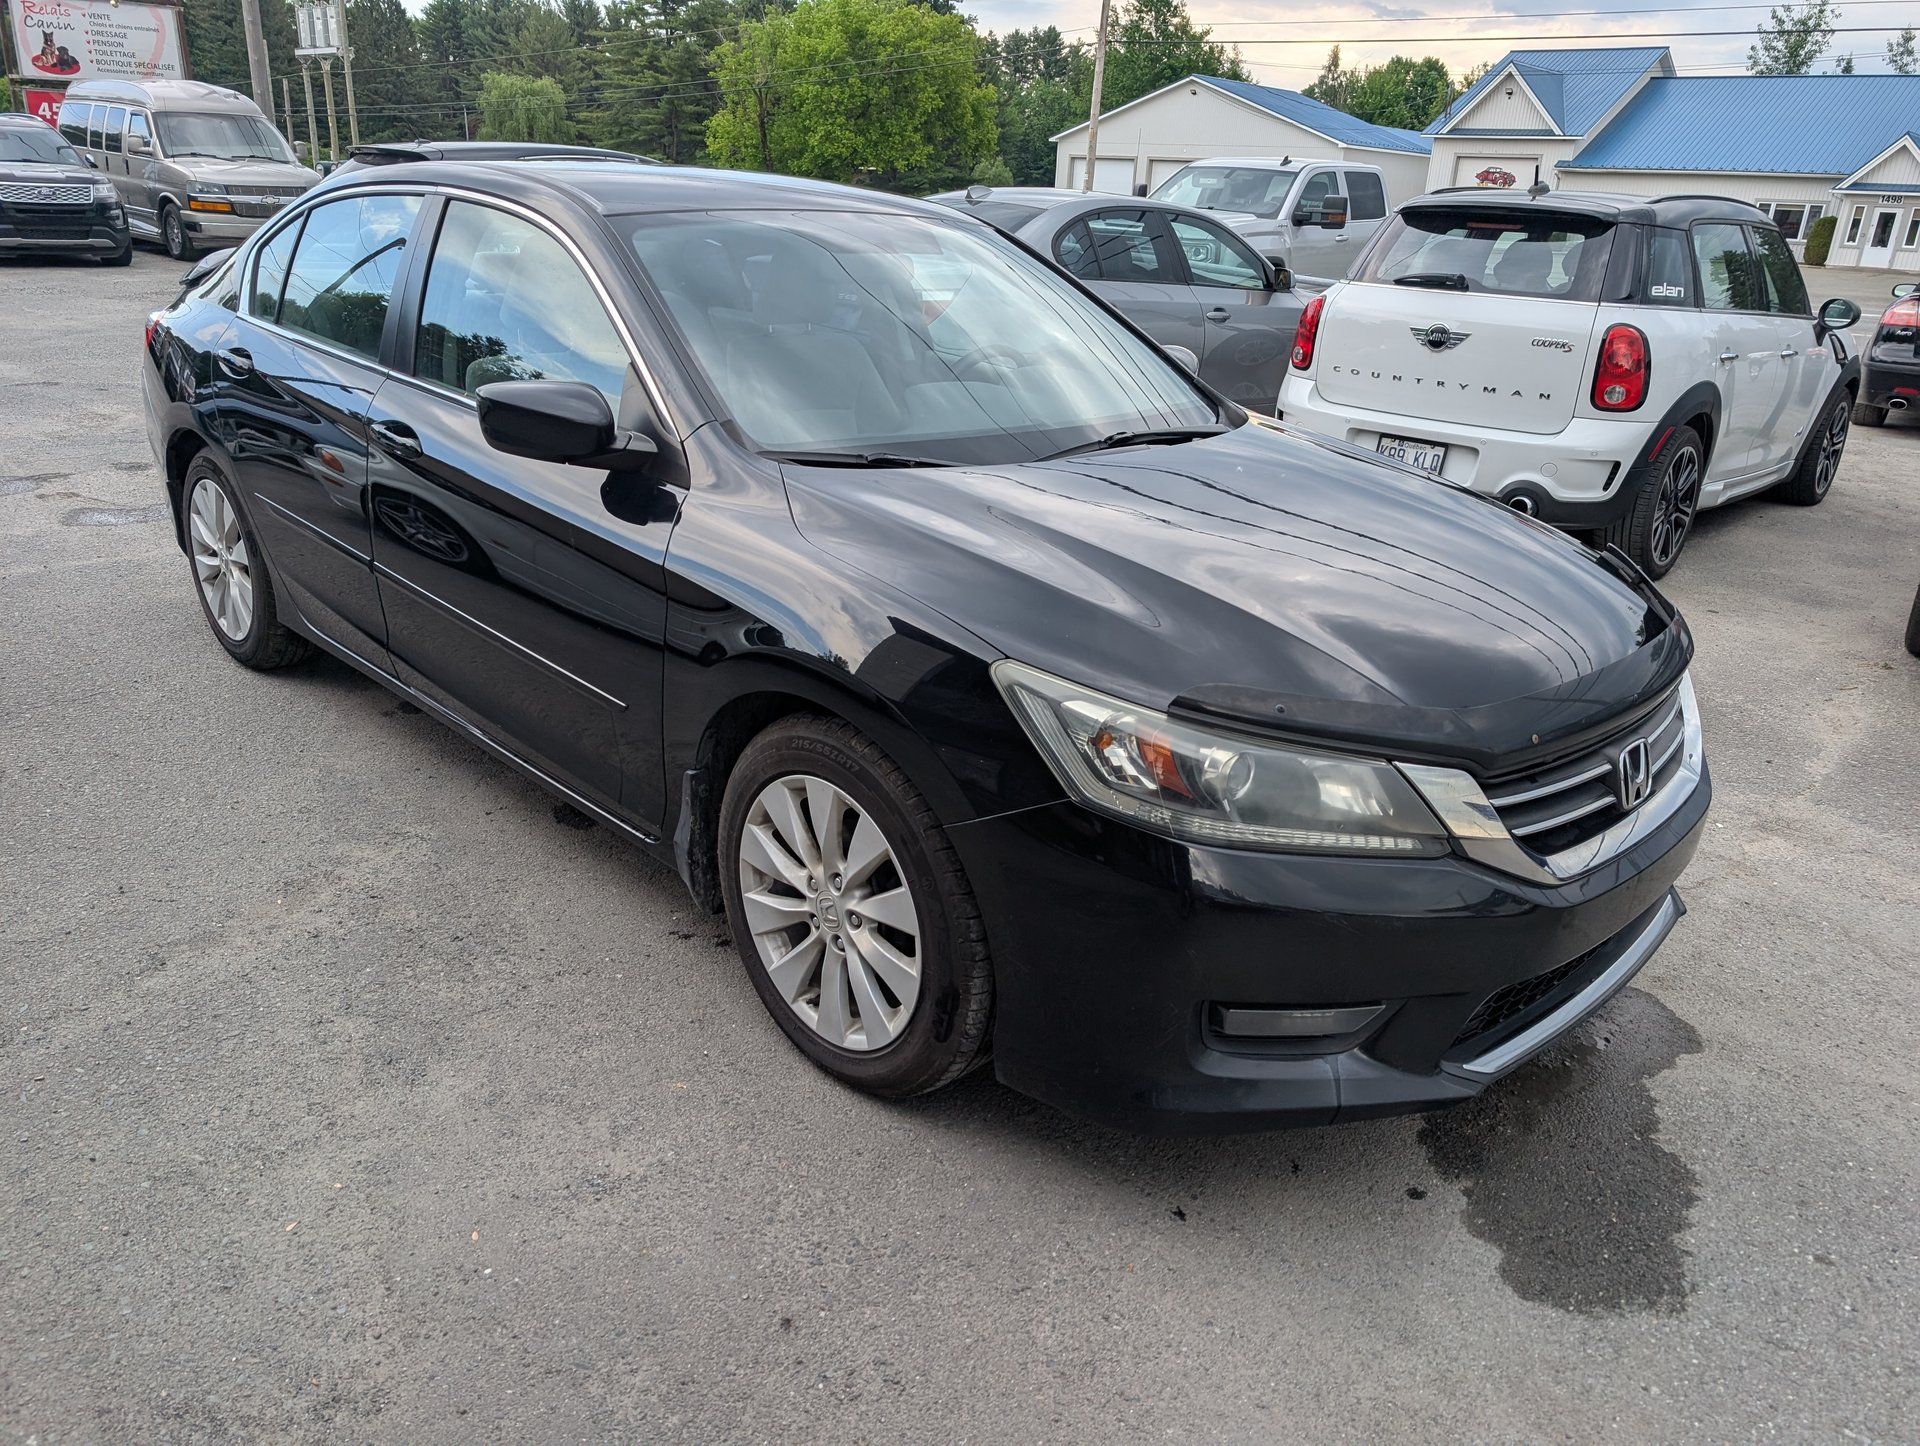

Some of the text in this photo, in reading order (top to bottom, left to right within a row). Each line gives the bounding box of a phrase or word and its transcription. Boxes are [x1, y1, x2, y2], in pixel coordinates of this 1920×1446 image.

[20, 1, 71, 17] Relais
[87, 13, 112, 21] VENTE
[24, 15, 75, 30] Canin
[91, 29, 128, 39] DRESSAGE
[92, 39, 124, 48] PENSION
[94, 49, 136, 58] TOILETTAGE
[95, 59, 132, 68] BOUTIQUE
[97, 67, 129, 75] Accessoires
[1881, 194, 1903, 204] 1498
[1651, 282, 1684, 298] elan
[1428, 332, 1449, 341] MINI
[1333, 365, 1551, 400] COUNTRYMAN
[1412, 450, 1441, 472] KLQ
